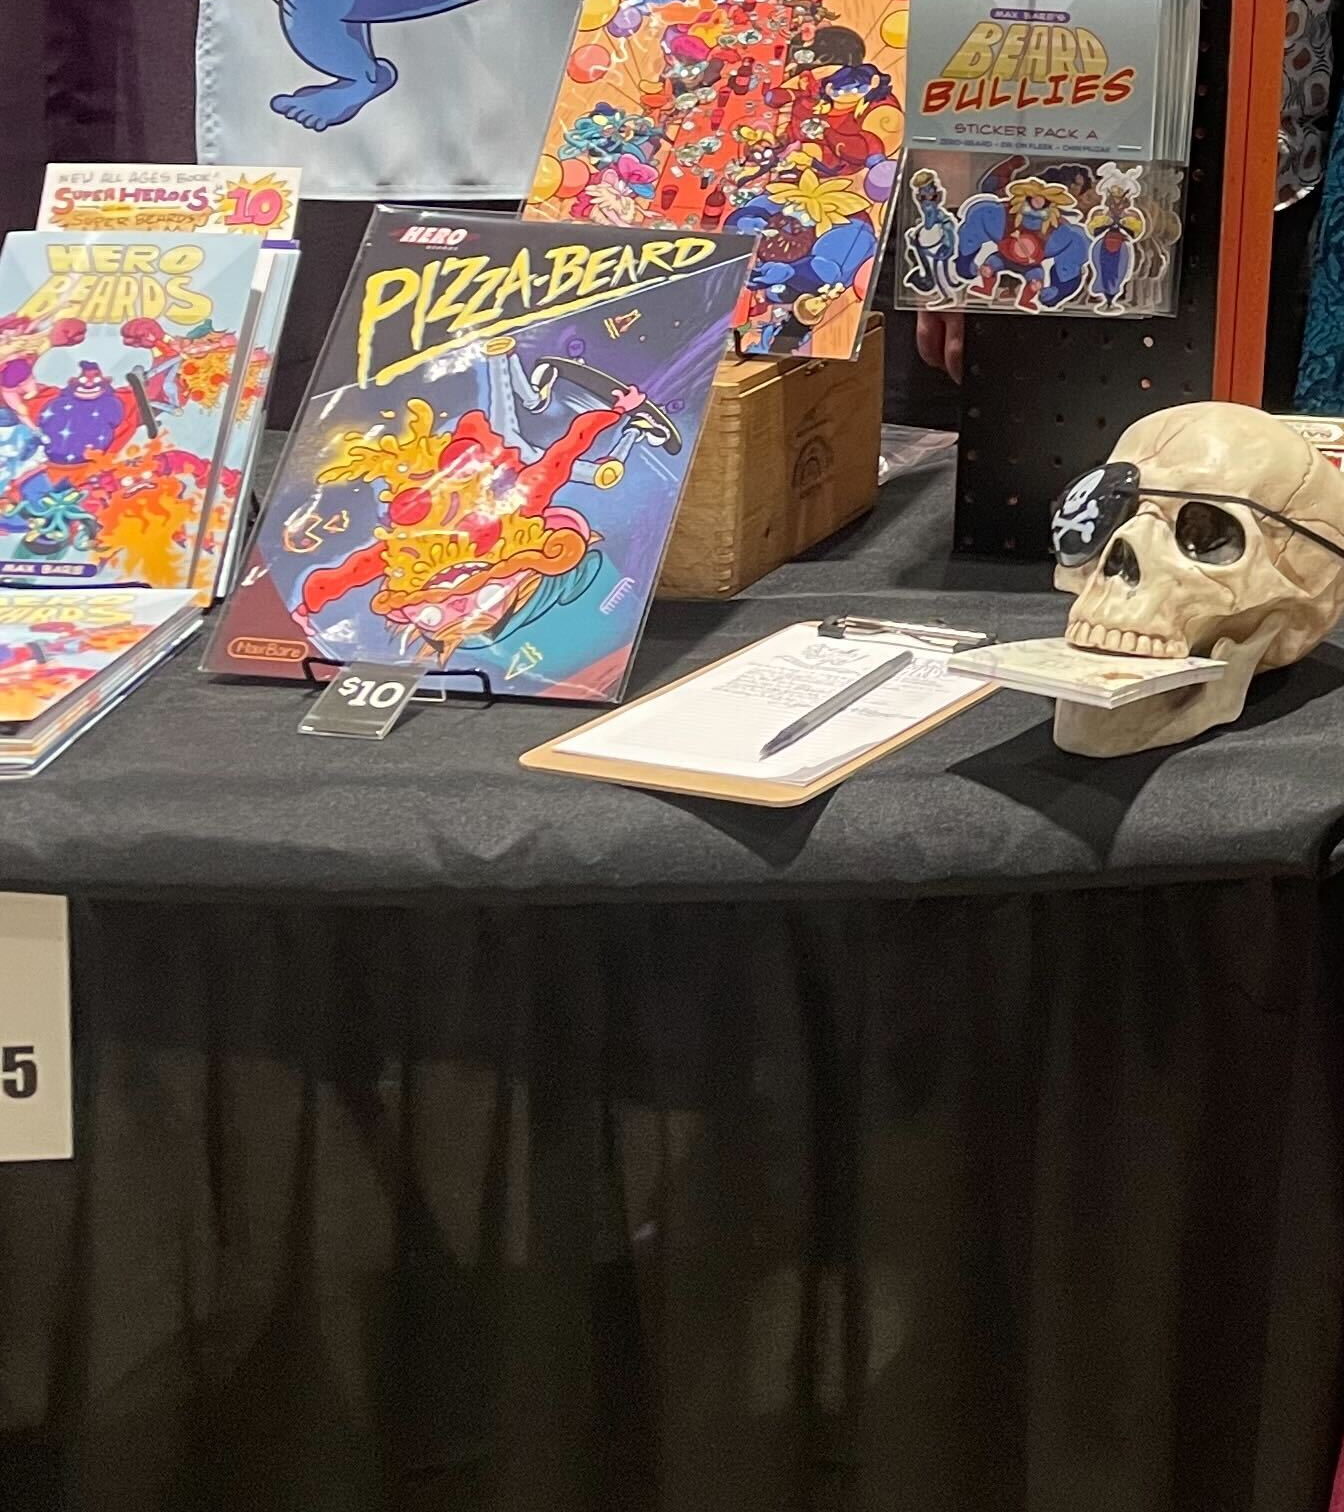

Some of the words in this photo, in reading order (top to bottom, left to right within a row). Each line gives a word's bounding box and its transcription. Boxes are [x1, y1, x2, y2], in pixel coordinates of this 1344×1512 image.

[940, 21, 1109, 84] BEARD
[921, 67, 1137, 116] BULLIES
[954, 123, 1028, 137] STICKER
[1034, 127, 1080, 139] PACK
[1086, 130, 1099, 140] A
[59, 172, 94, 184] NEW
[101, 172, 121, 183] ALL
[128, 172, 171, 184] AGES
[72, 214, 130, 226] SUPER
[400, 226, 468, 247] HERO
[46, 244, 205, 275] HERO
[16, 273, 214, 326] BEARDS
[357, 236, 717, 390] PIZZA-BEARD
[338, 675, 406, 710] $10
[2, 1045, 38, 1100] 5
